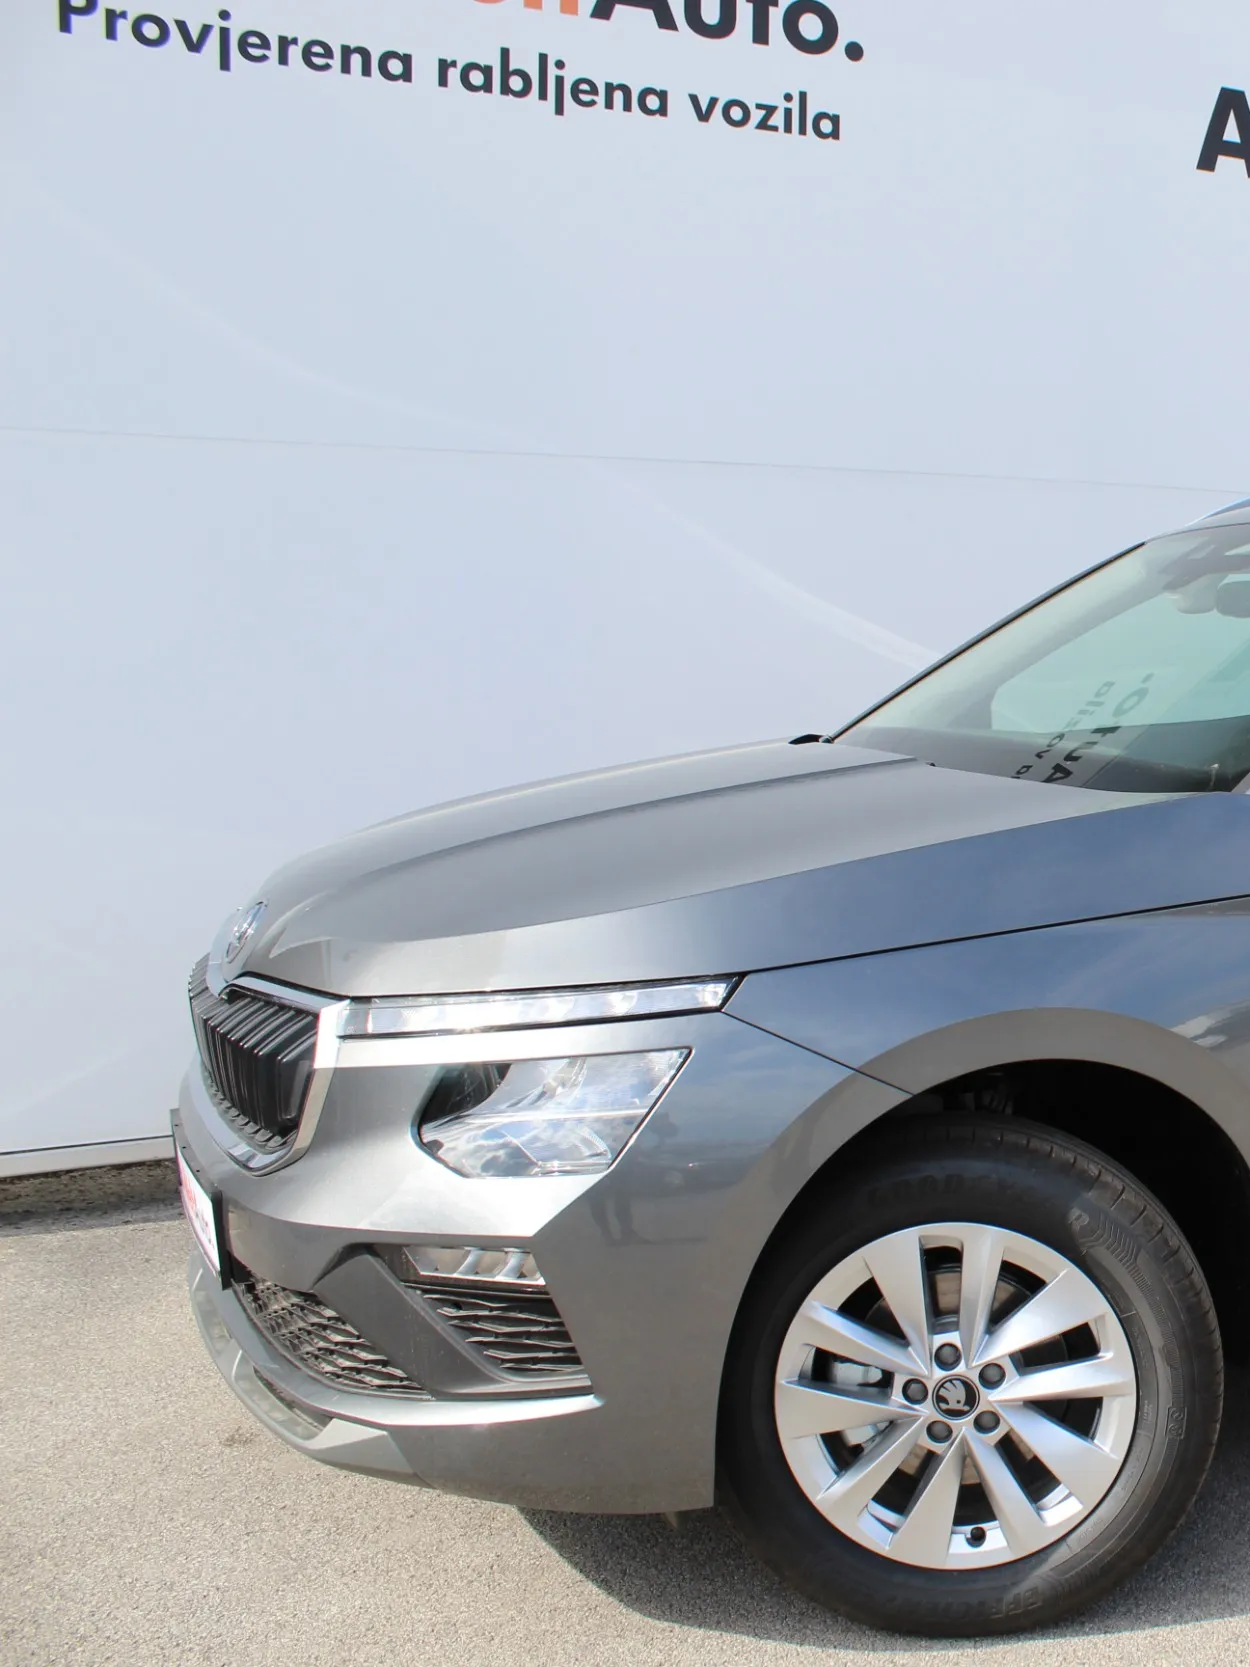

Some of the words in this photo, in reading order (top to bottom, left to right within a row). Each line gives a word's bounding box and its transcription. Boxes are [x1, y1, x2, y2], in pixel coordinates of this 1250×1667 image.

[58, 0, 413, 83] Provjerena
[437, 46, 669, 117] rabljena
[688, 91, 842, 141] vozila
